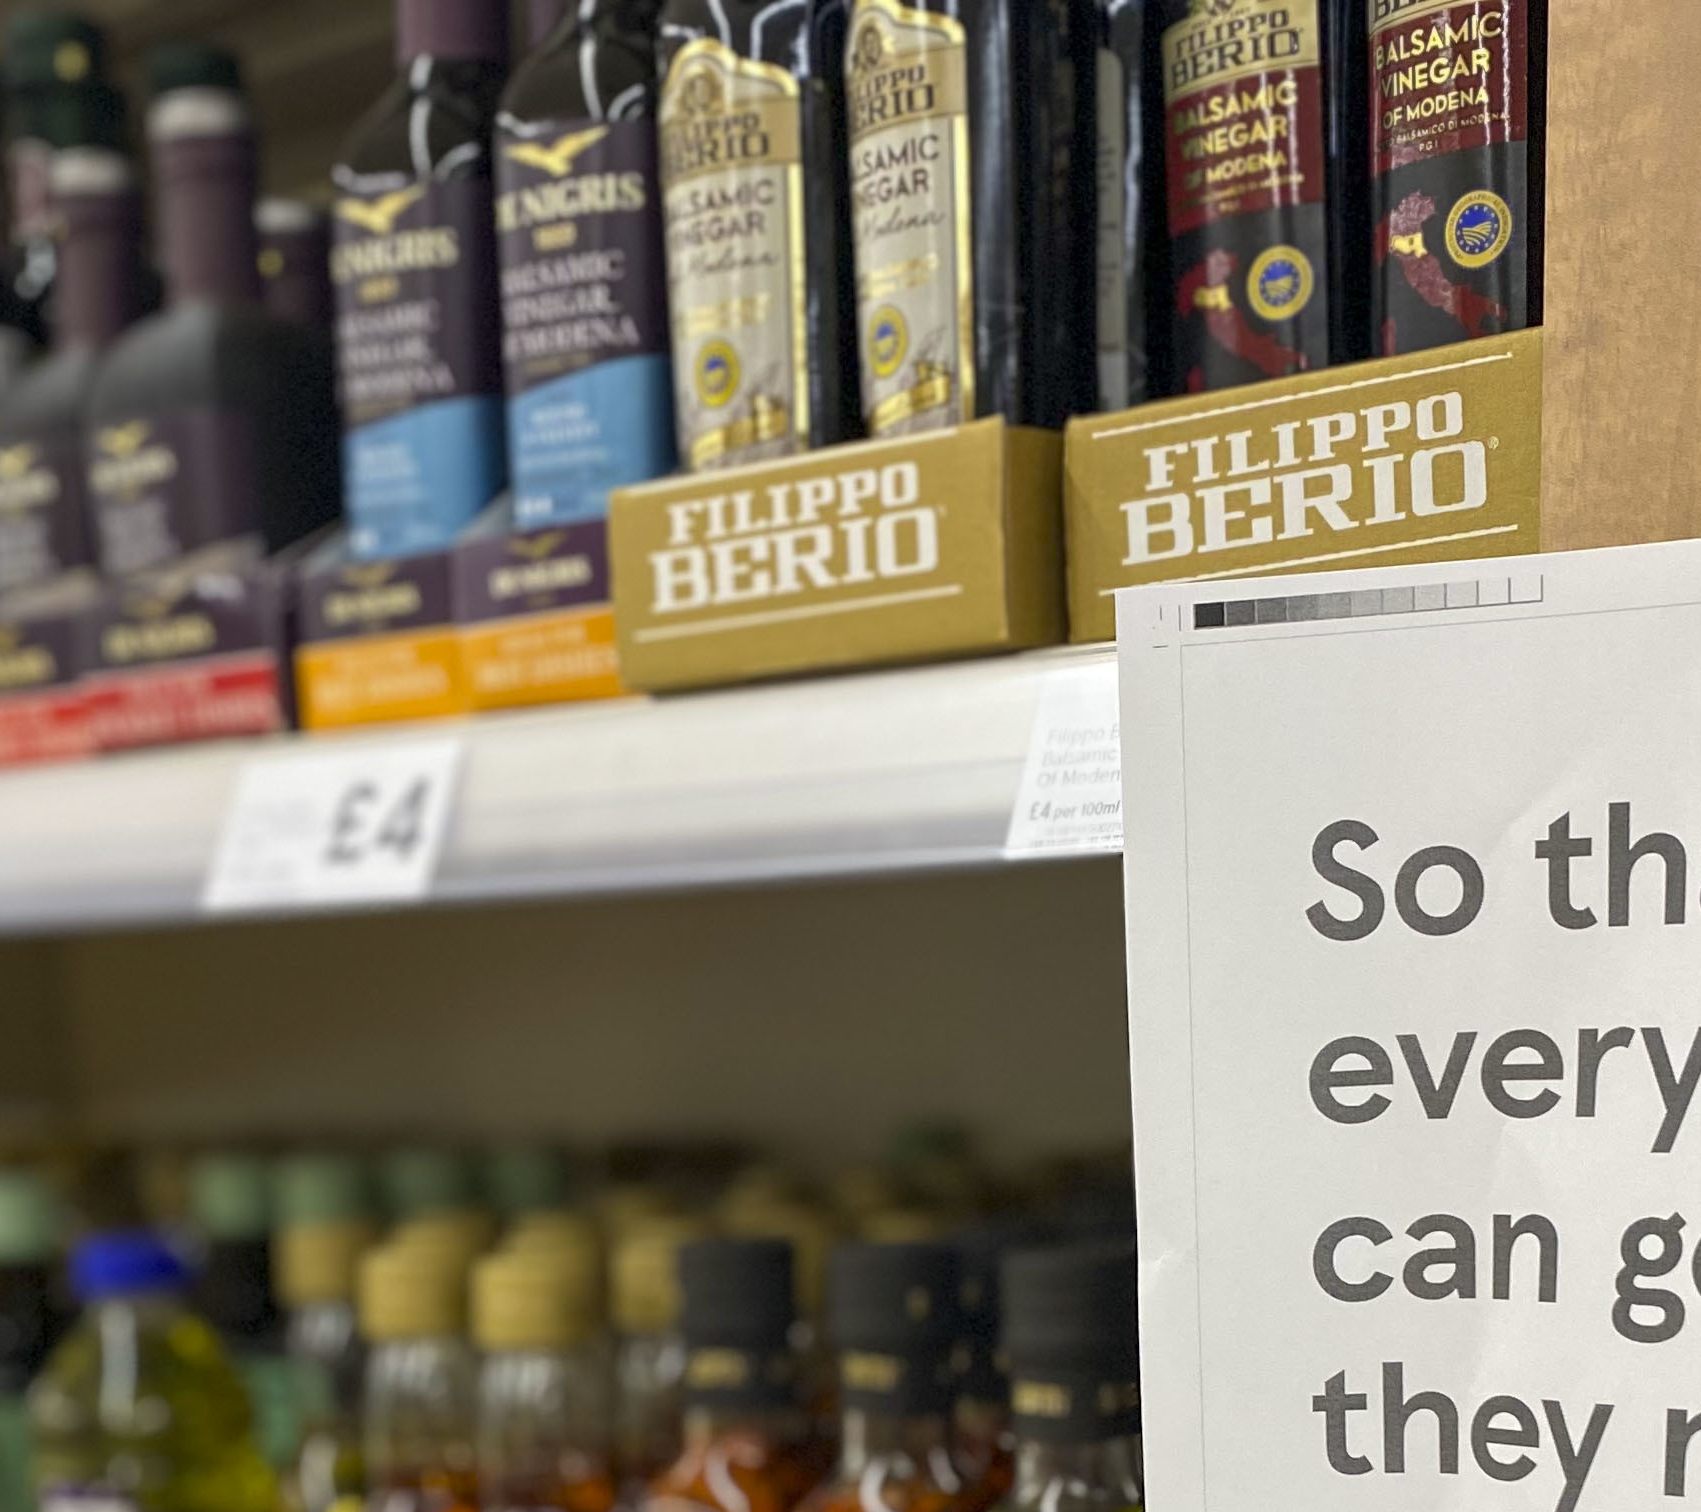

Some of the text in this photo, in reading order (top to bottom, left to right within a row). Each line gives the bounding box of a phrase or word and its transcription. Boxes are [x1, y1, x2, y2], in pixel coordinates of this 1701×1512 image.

[1171, 29, 1299, 88] BERIO
[1175, 9, 1289, 58] FILIPPO
[1375, 11, 1502, 71] BALSAMIC
[1173, 79, 1297, 136] BALSAMIC
[1381, 48, 1490, 98] VINEGAR
[1383, 86, 1489, 130] OF MODENA
[1181, 115, 1288, 160] VINEGAR
[1206, 150, 1288, 183] MODENA
[1143, 391, 1463, 491] FILIPPO
[668, 461, 919, 545] FILIPPO
[1119, 440, 1487, 566] BERIO
[648, 506, 939, 614] BERIO
[324, 776, 428, 867] £4
[1306, 801, 1701, 942] So th
[1309, 1026, 1701, 1153] every
[1313, 1212, 1701, 1344] can g
